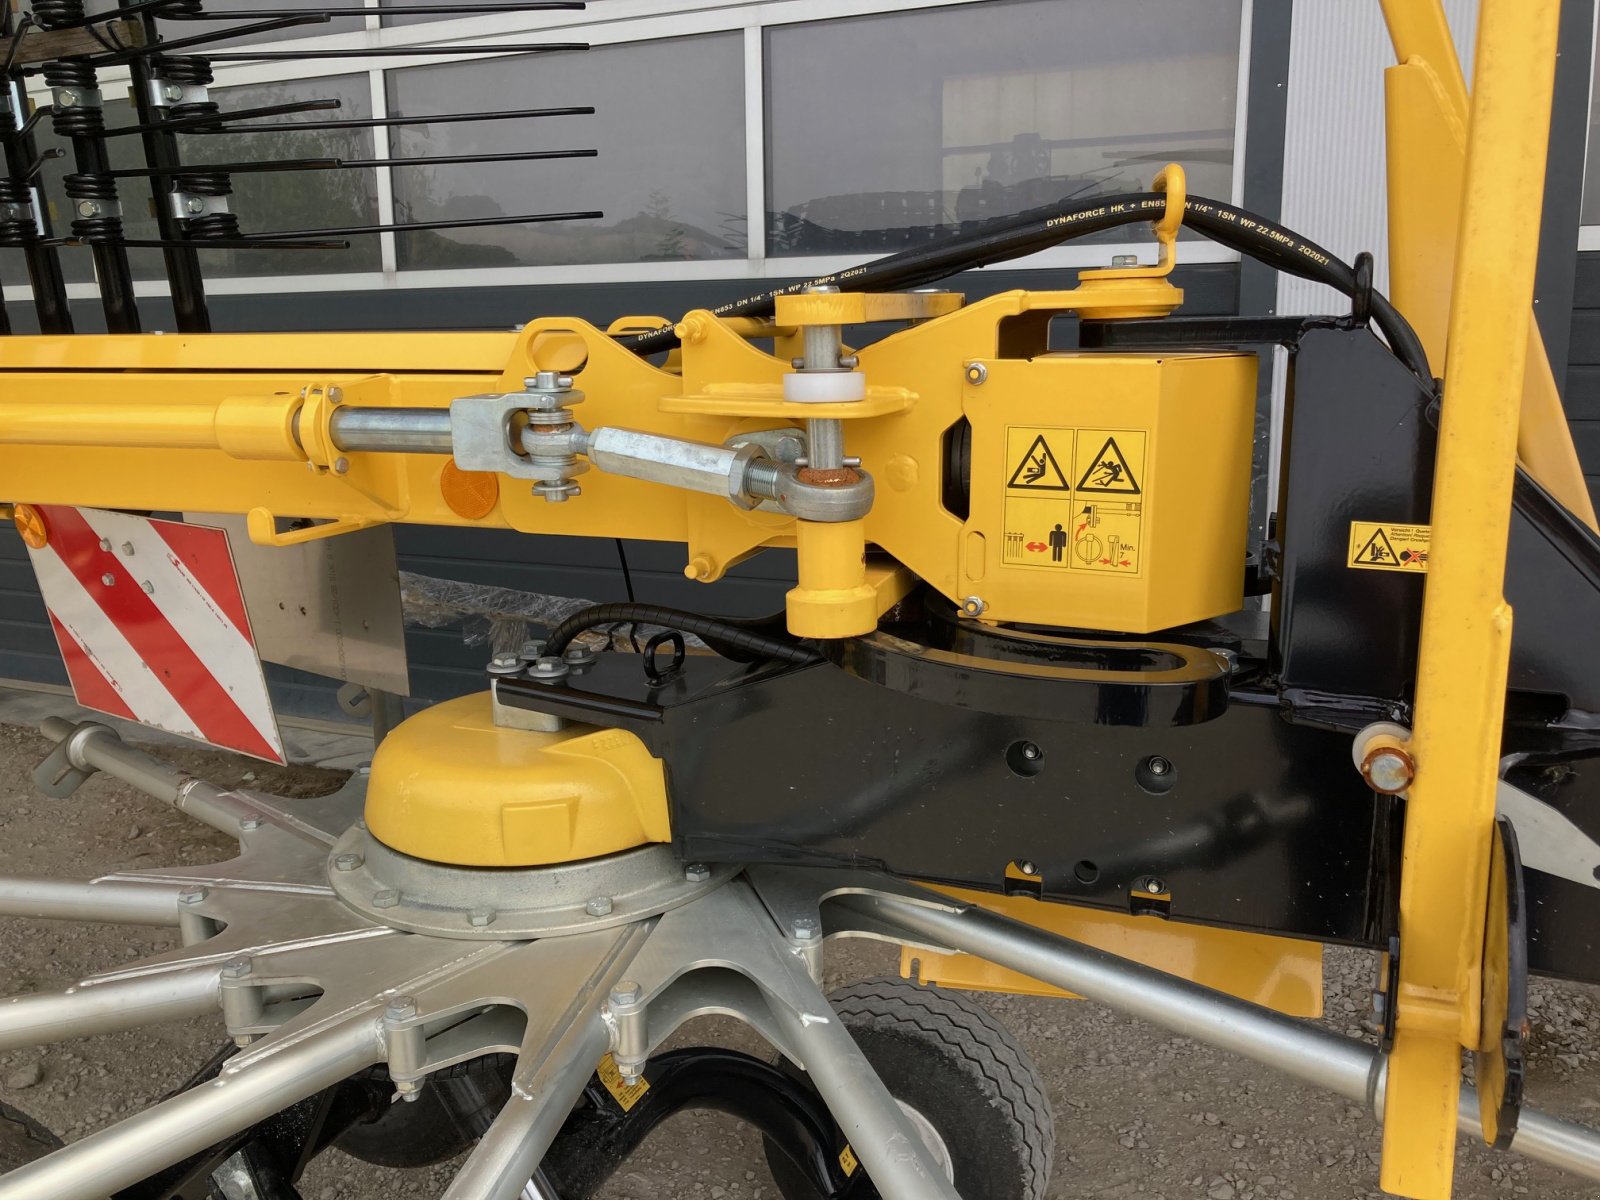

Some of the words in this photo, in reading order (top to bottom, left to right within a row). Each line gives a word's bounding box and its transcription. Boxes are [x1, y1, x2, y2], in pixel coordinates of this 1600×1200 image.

[1046, 207, 1105, 227] DYNAFORCE
[1110, 204, 1125, 213] HK
[1141, 199, 1166, 208] EN85
[1217, 210, 1236, 222] 1SN
[1239, 217, 1256, 229] WP
[1256, 224, 1295, 248] 22.5MPa
[1297, 244, 1330, 266] 2Q2021
[638, 322, 678, 341] DYNAFORC
[736, 299, 748, 307] DN
[769, 288, 784, 298] 1SN
[788, 284, 801, 293] WP
[803, 276, 836, 288] 22.5MPa
[840, 267, 867, 279] 2Q2021
[1120, 543, 1136, 551] Min.
[1120, 551, 1125, 559] 7
